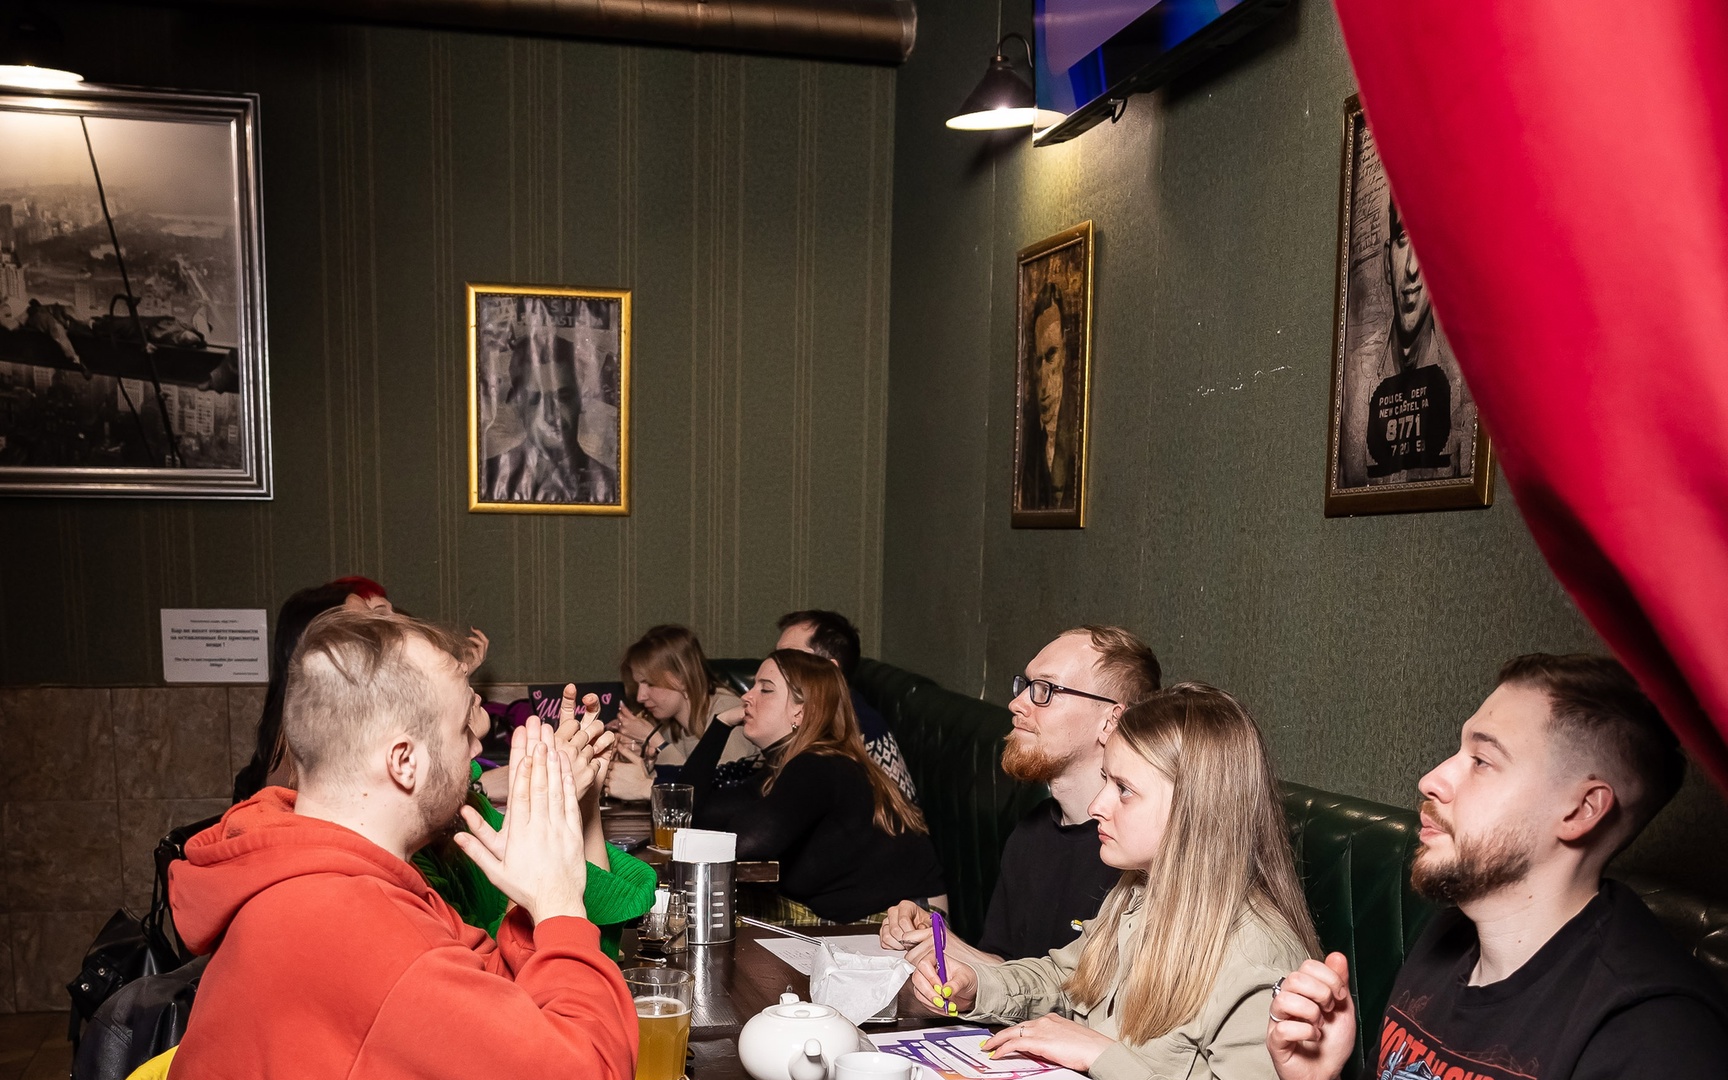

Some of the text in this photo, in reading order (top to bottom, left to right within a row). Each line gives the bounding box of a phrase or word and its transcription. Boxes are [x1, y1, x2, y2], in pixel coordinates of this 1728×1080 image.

[1378, 386, 1428, 406] POLICE DEPT
[1378, 407, 1393, 419] NEW
[1385, 413, 1421, 442] 8771
